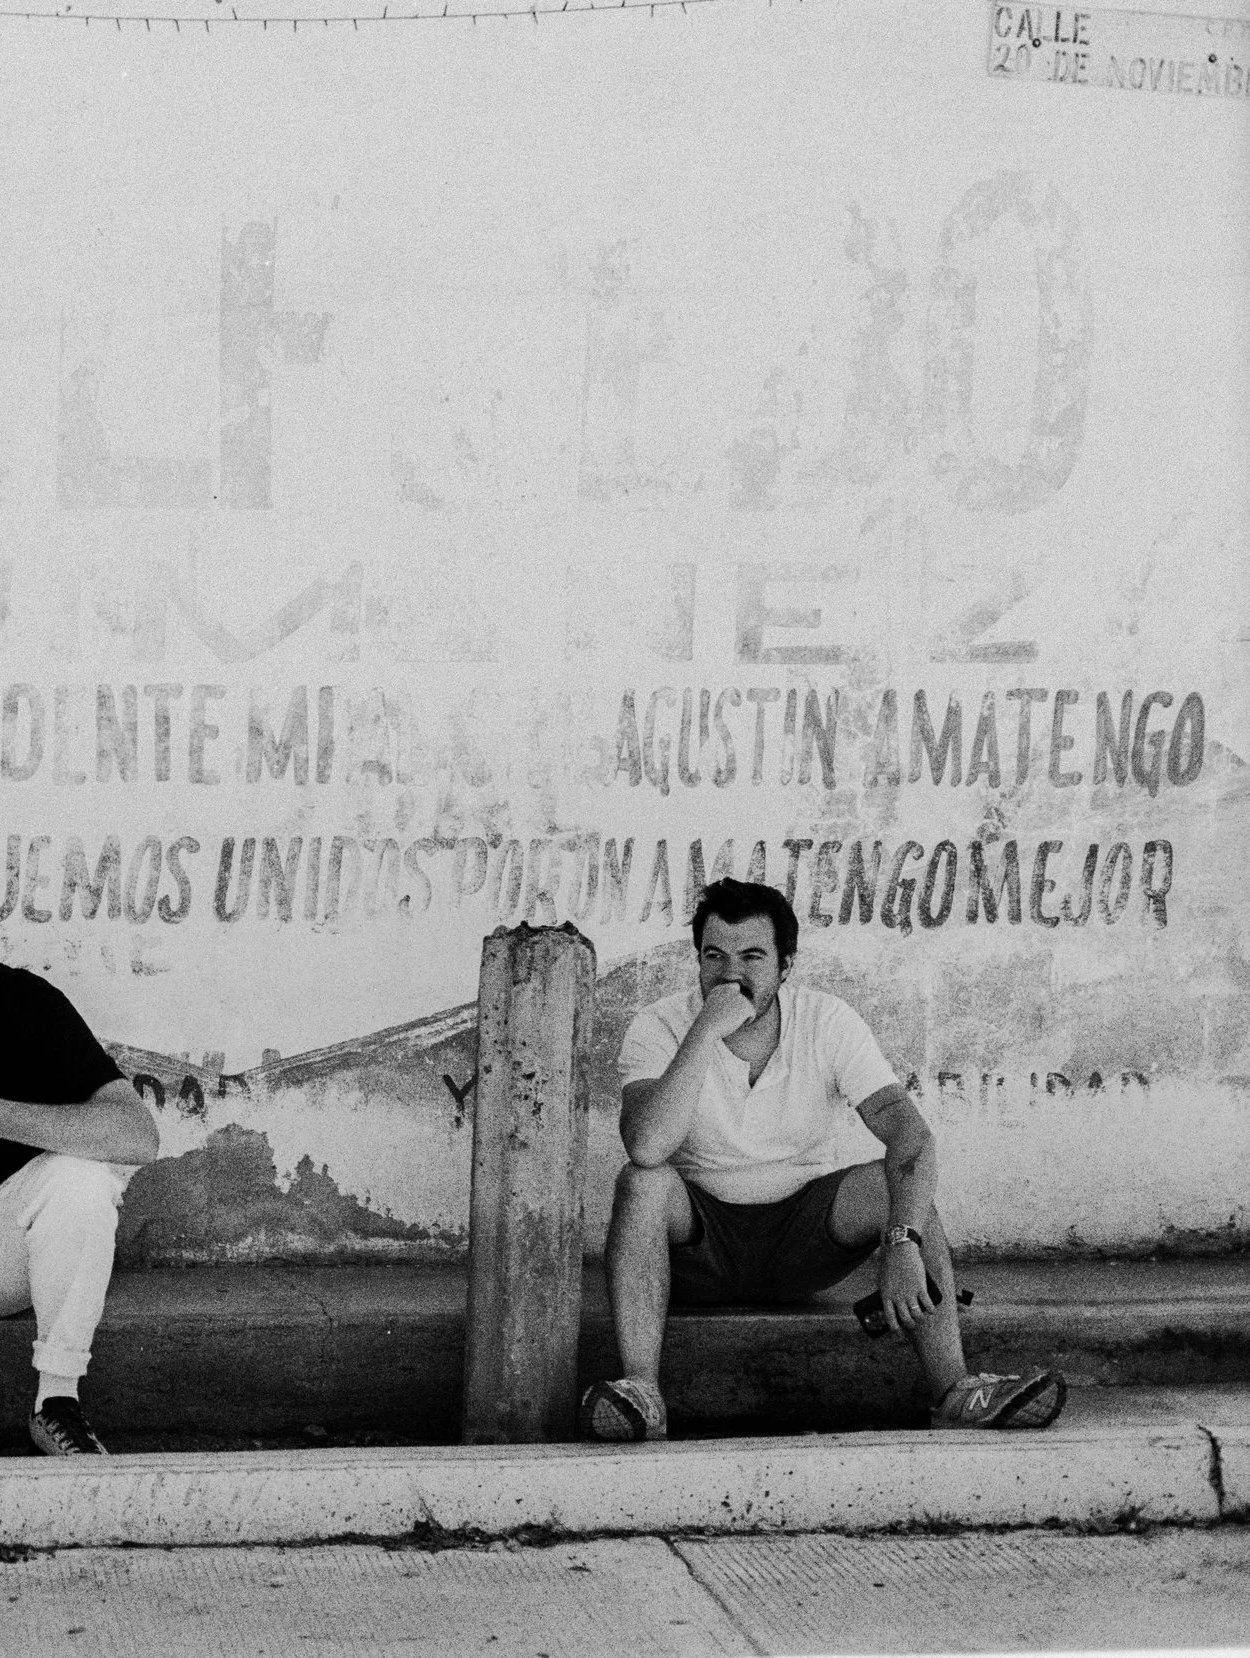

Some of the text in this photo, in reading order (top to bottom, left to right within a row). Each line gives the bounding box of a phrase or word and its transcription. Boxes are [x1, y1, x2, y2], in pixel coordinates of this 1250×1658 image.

[994, 6, 1091, 46] CALLE
[1106, 54, 1250, 97] NOVIEMB
[612, 687, 842, 797] AGUSTIN
[862, 687, 1206, 798] AMATENGO
[212, 834, 436, 924] UNIDOS
[961, 836, 1175, 930] MEJOR
